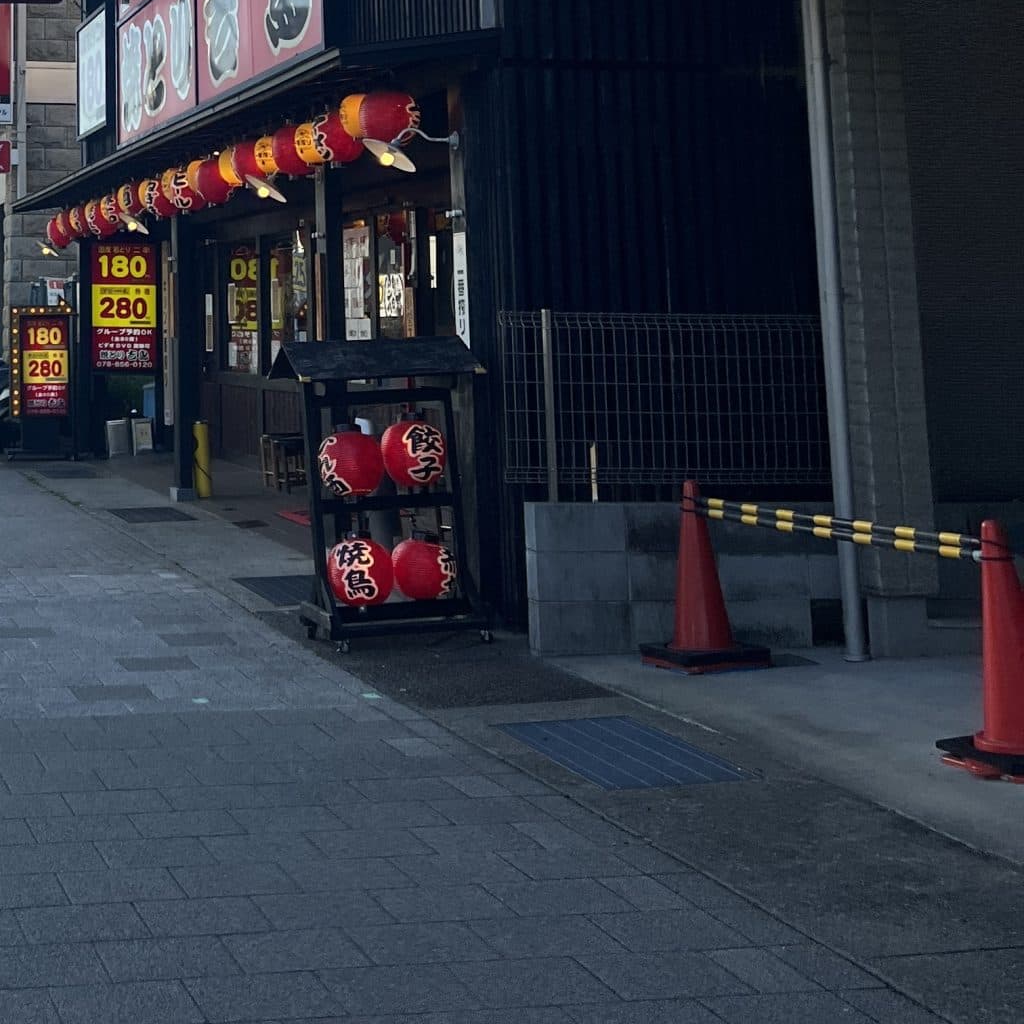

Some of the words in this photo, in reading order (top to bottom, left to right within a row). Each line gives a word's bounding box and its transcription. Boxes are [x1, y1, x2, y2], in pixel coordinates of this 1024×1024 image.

[98, 255, 147, 278] 180
[99, 296, 147, 320] 280
[27, 327, 62, 345] 180
[28, 360, 62, 377] 280
[403, 424, 444, 482] 餃子
[335, 540, 378, 599] 焼鳥
